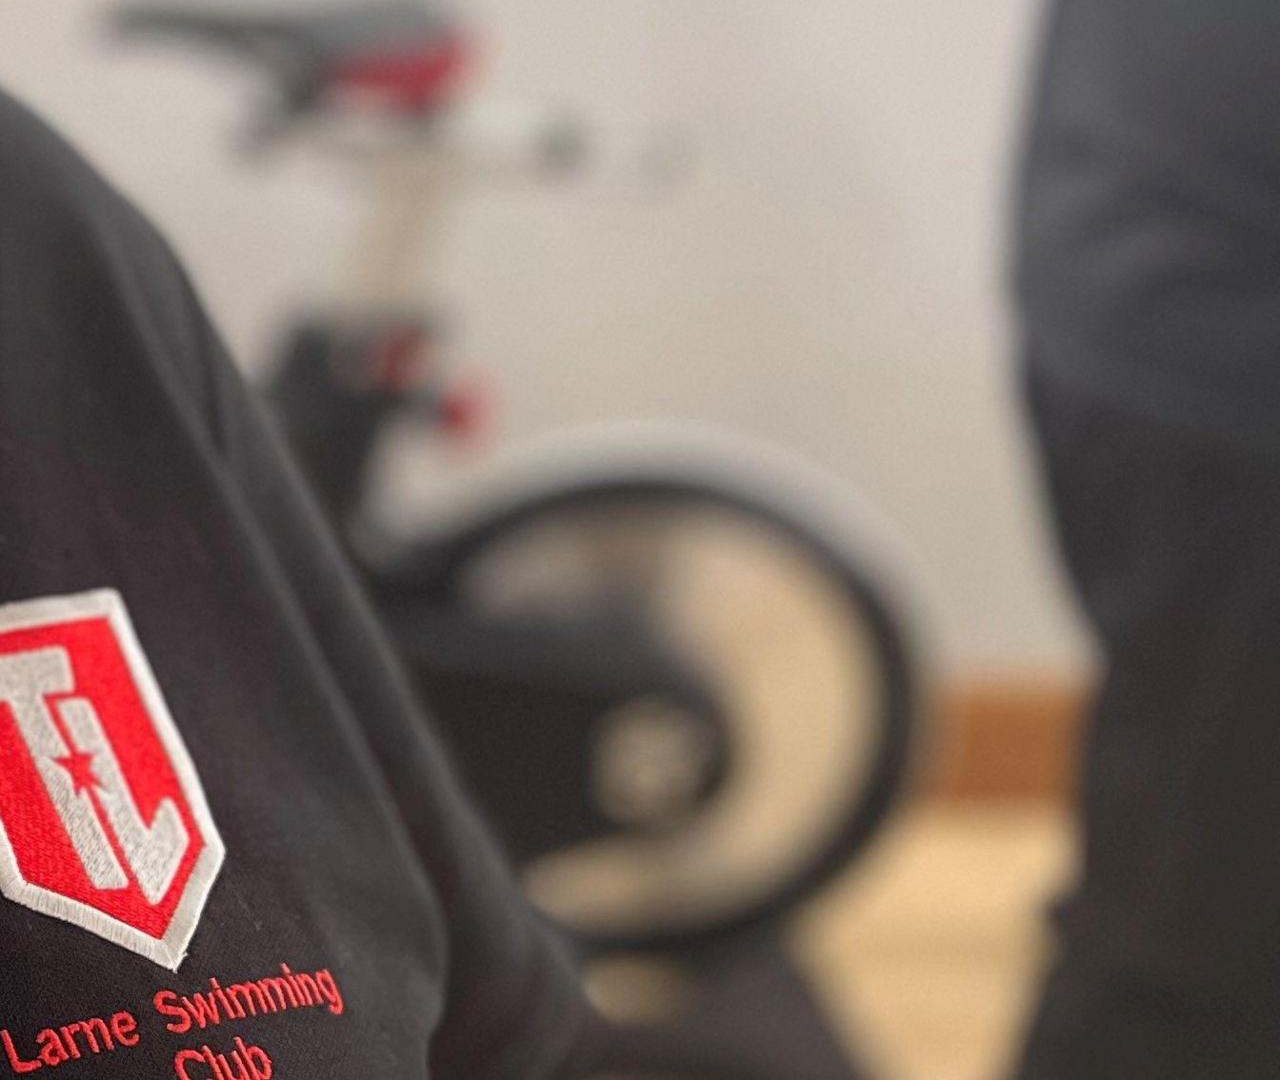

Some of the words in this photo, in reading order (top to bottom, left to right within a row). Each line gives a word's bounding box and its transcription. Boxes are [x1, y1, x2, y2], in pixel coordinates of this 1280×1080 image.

[0, 1010, 140, 1074] Larne
[153, 963, 344, 1034] Swimming
[174, 1036, 273, 1080] Club
